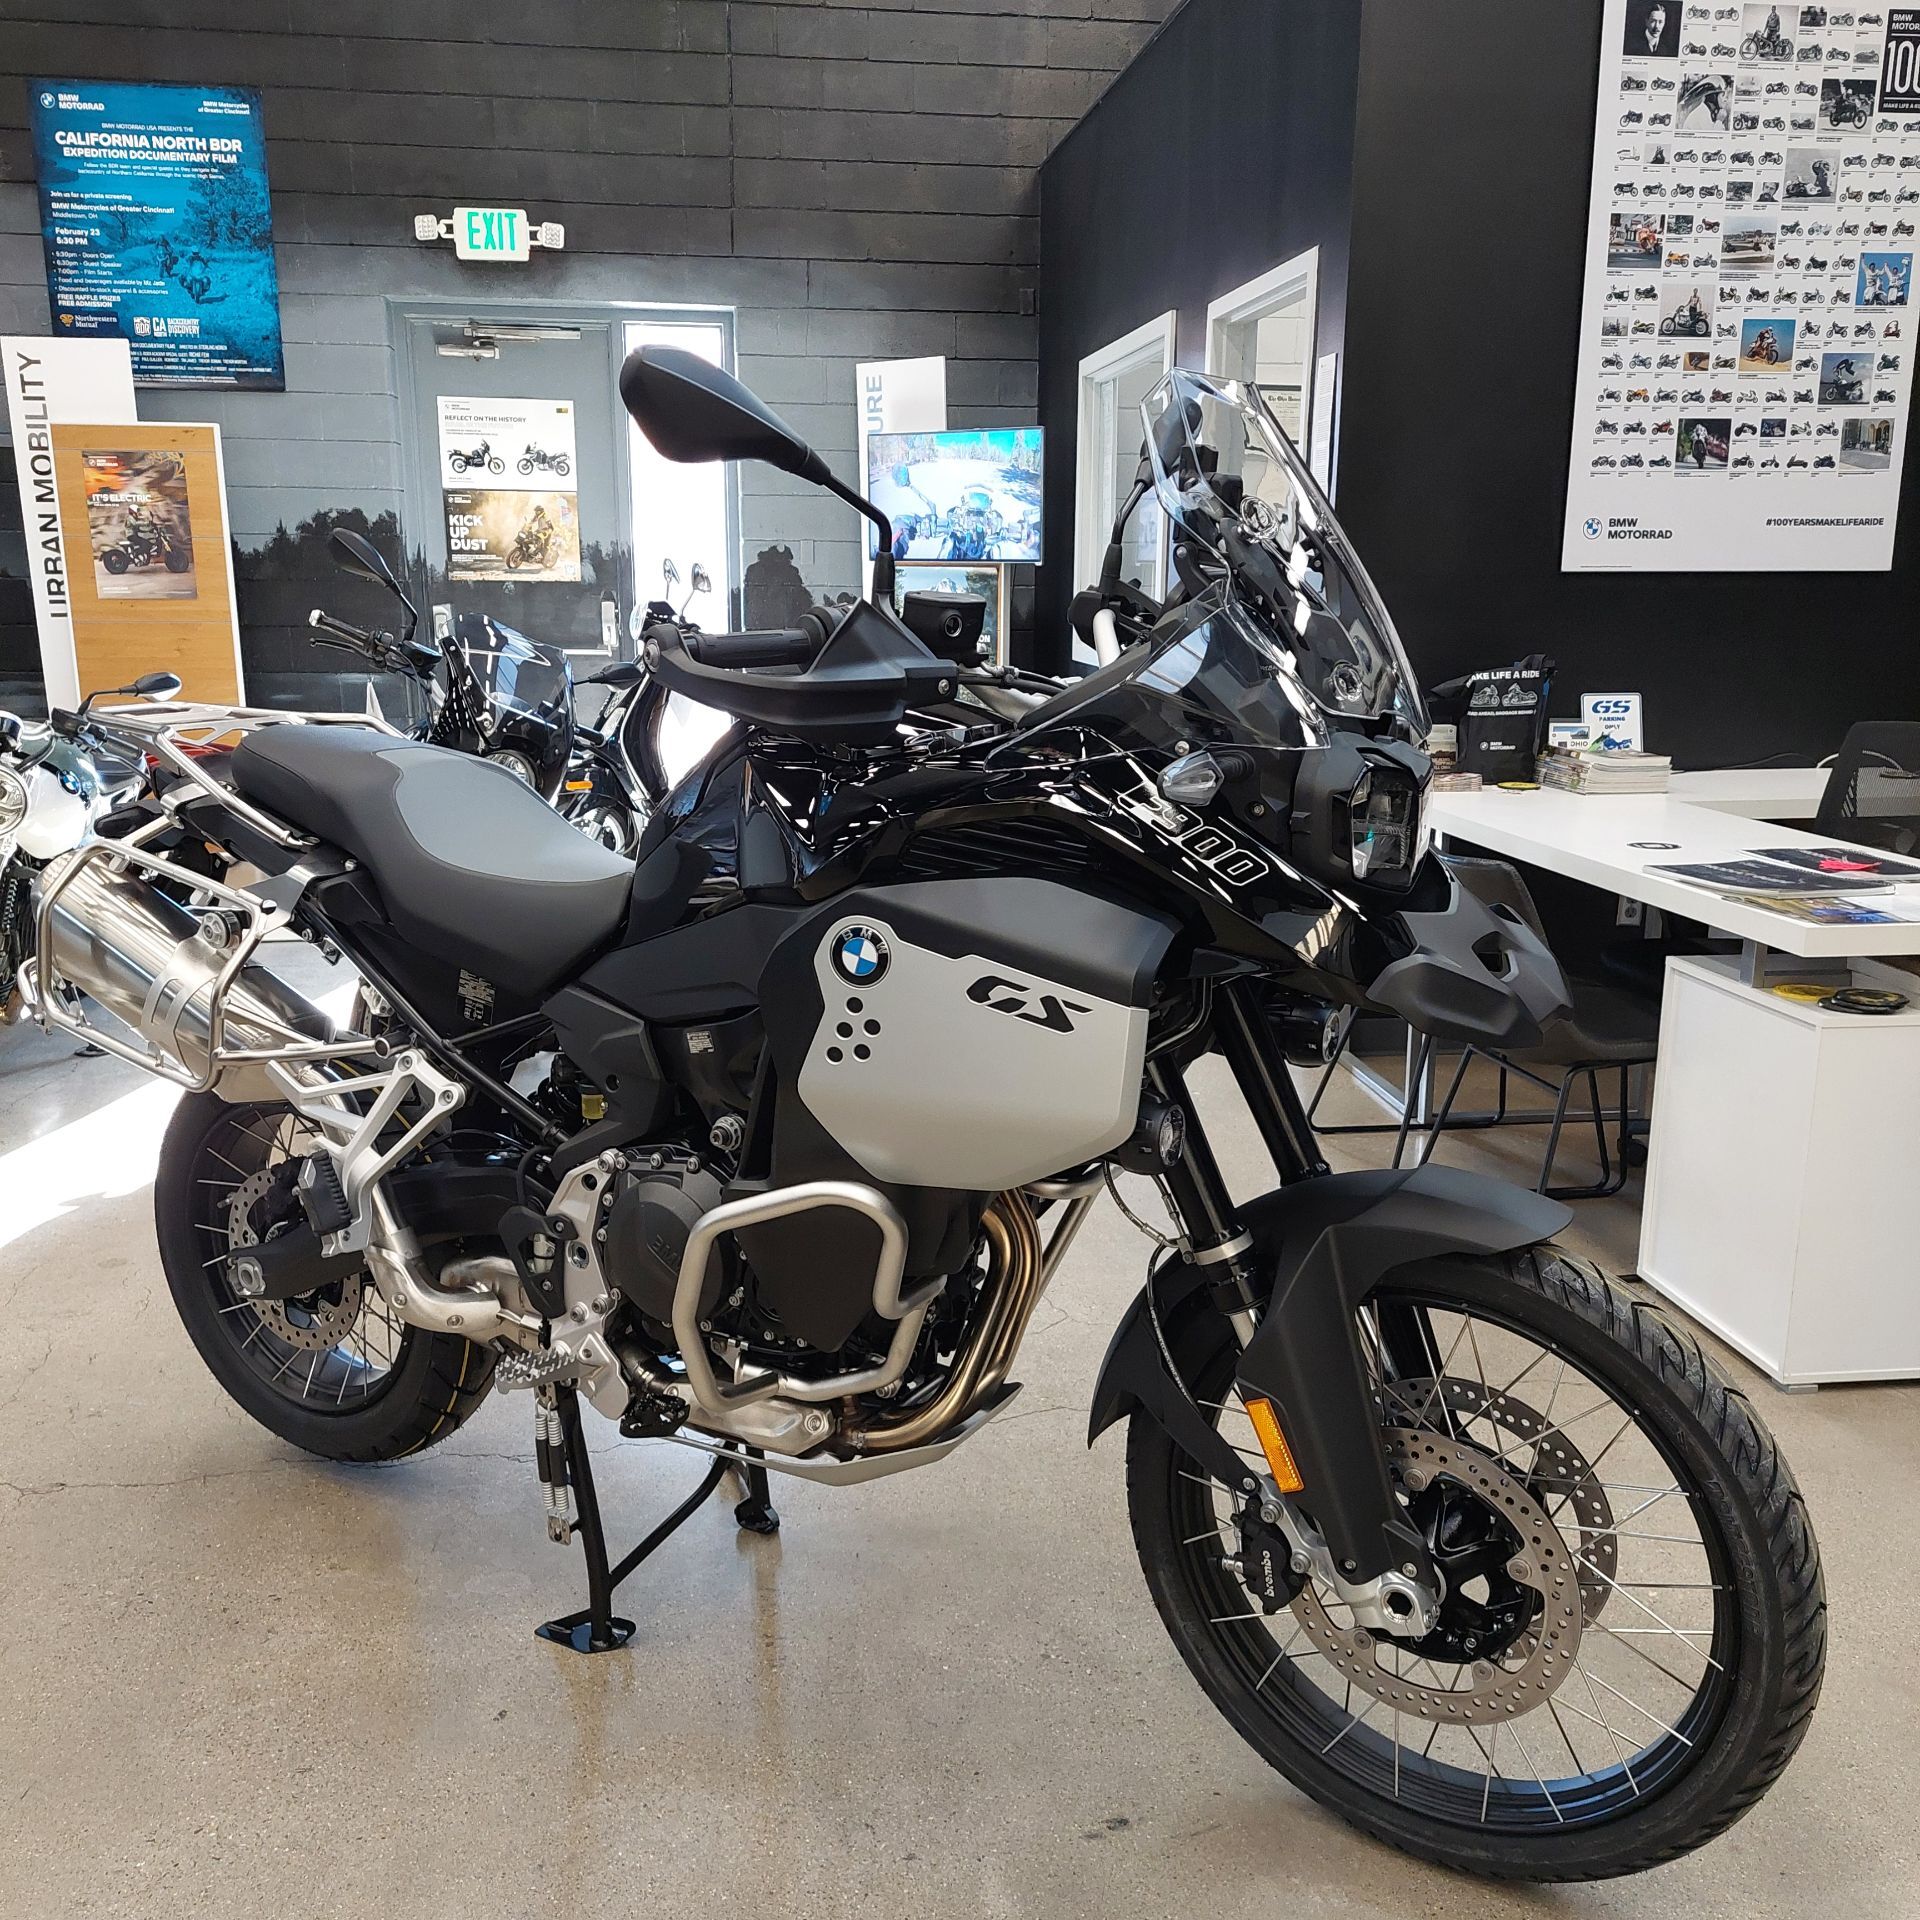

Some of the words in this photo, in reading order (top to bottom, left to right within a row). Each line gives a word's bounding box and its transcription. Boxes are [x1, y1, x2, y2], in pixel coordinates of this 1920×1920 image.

[58, 93, 79, 102] BMW
[59, 102, 105, 111] MOTORRAD
[55, 131, 150, 148] CALIFORNIA
[152, 136, 207, 151] NORTH
[209, 138, 243, 152] BDR
[63, 147, 128, 158] EXPEDITION
[130, 150, 210, 162] DOCUMENTARY
[212, 153, 237, 163] FILM
[50, 190, 62, 198] Join
[84, 192, 104, 200] private
[105, 193, 132, 201] screening
[52, 202, 69, 210] BMW
[70, 203, 109, 212] Motorcycles
[110, 204, 116, 212] of
[142, 206, 174, 214] Cincinnati
[52, 211, 87, 219] Middletown,
[55, 227, 88, 236] February
[90, 228, 100, 236] 23
[467, 212, 517, 250] EXIT
[75, 238, 88, 246] PM
[75, 314, 118, 323] Northwestern
[136, 323, 150, 334] BDR
[152, 317, 166, 332] CA
[168, 324, 200, 334] DISCOVERY
[16, 352, 55, 502] MOBILITY
[92, 494, 108, 502] IT'S
[110, 494, 152, 502] ELECTRIC
[448, 514, 484, 526] KICK
[1608, 518, 1638, 528] BMW
[1766, 518, 1884, 527] #100YEARSMAKELIFEARIDE
[450, 526, 469, 538] UP
[1608, 529, 1672, 540] MOTORRAD
[450, 538, 488, 550] DUST
[38, 514, 68, 618] URBAN
[1491, 671, 1512, 680] LIFE
[1513, 670, 1520, 678] A
[1522, 670, 1540, 678] RIDE
[1592, 700, 1632, 714] GS
[841, 927, 888, 954] BMW
[966, 976, 1093, 1034] GS
[1260, 1550, 1274, 1598] brembo
